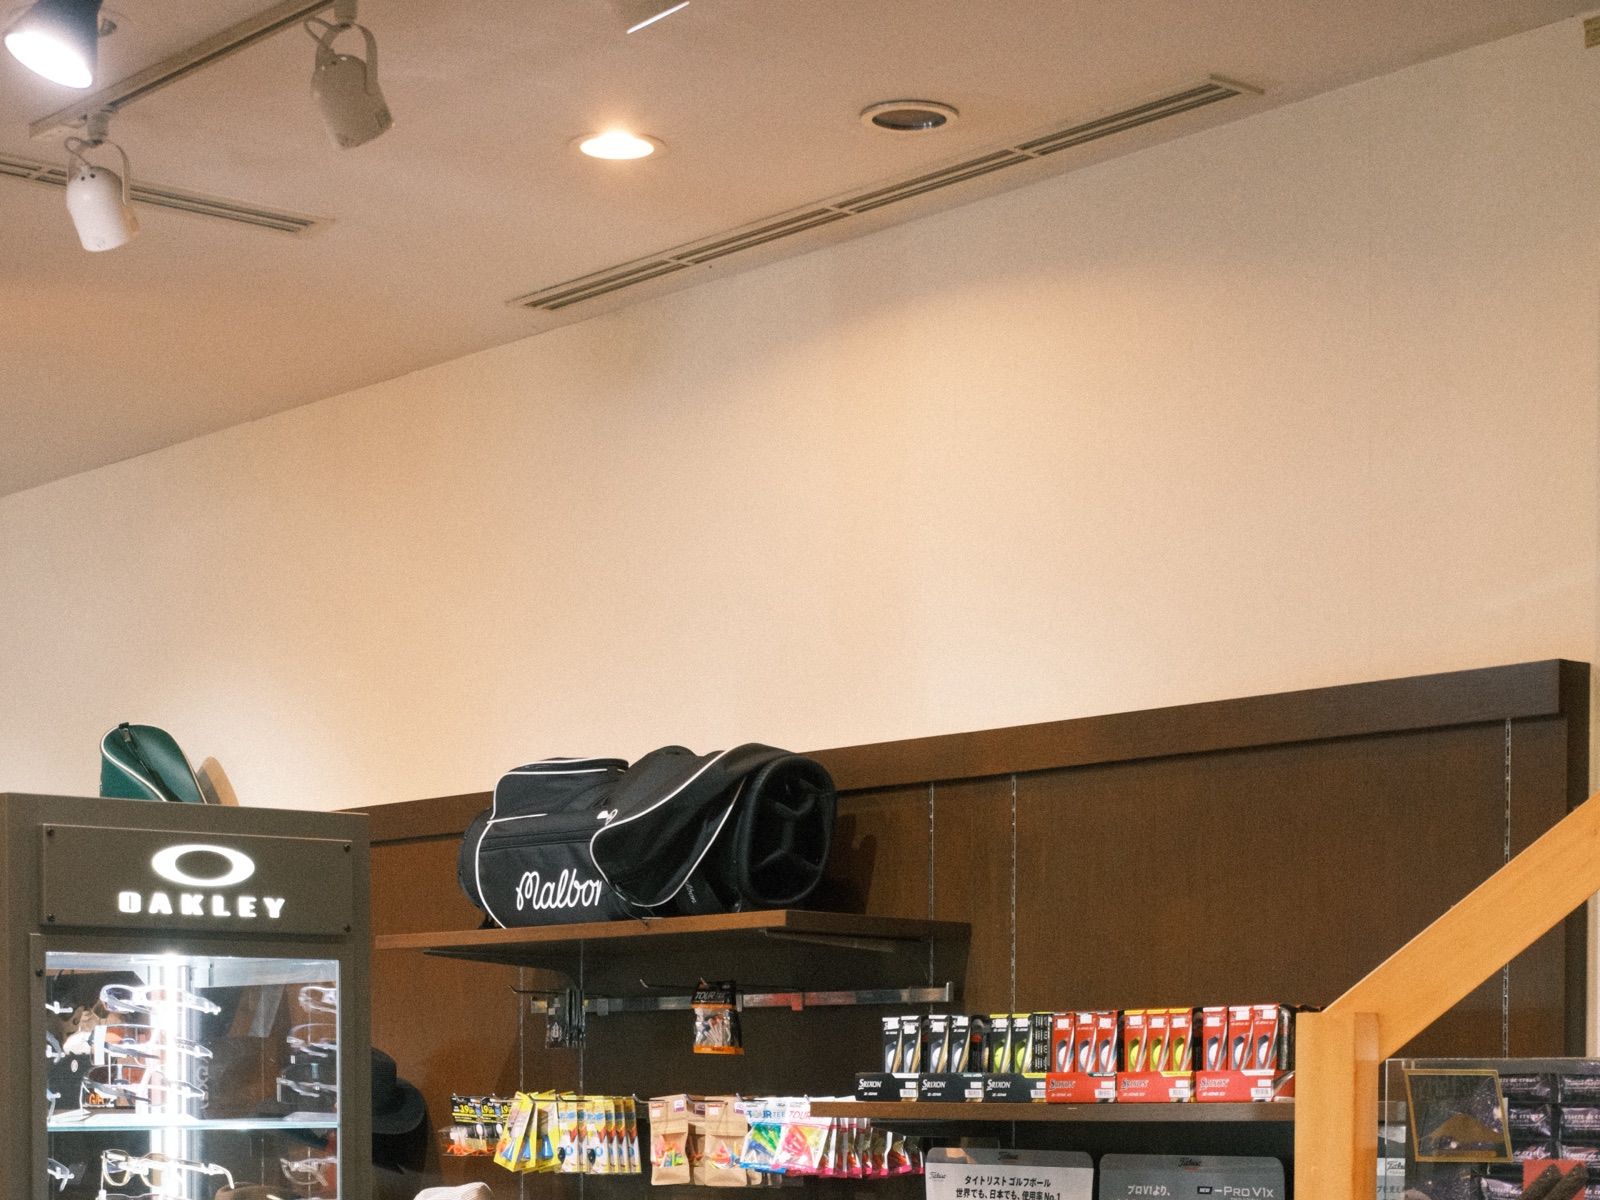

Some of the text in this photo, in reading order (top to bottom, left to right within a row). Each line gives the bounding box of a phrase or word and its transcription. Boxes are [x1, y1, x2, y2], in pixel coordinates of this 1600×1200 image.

[118, 891, 286, 918] OAKLEY
[858, 1078, 882, 1090] SRIXON
[921, 1078, 946, 1090] SRIXON
[986, 1078, 1011, 1091] SRIXON
[964, 1175, 1052, 1188] タイトリスト ゴルフボール
